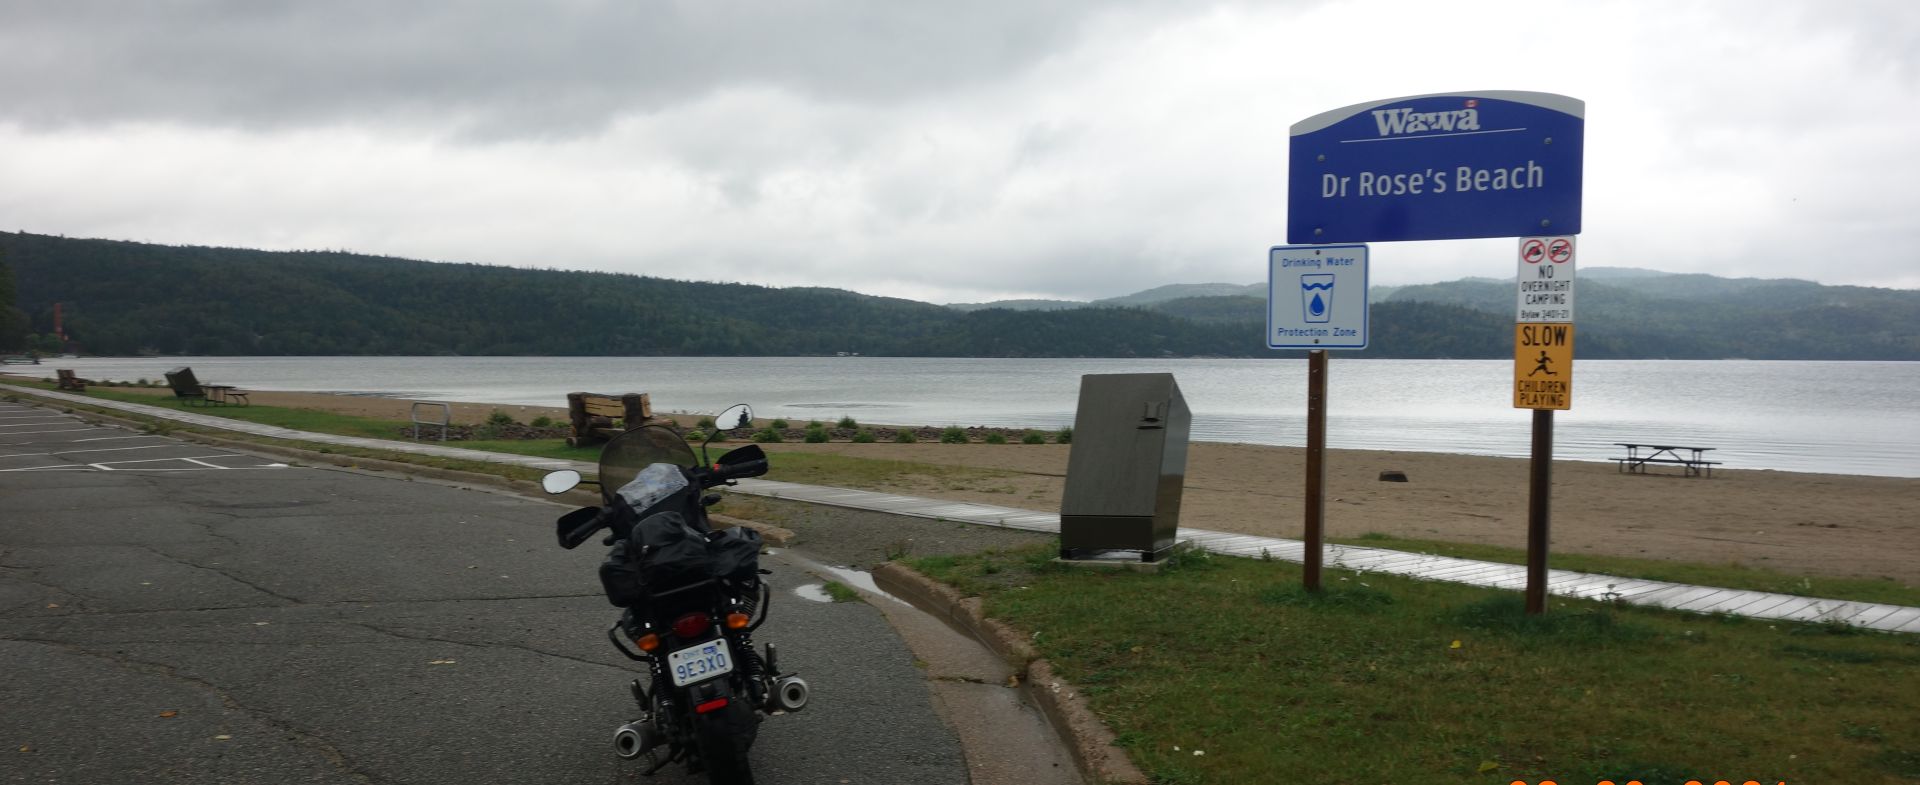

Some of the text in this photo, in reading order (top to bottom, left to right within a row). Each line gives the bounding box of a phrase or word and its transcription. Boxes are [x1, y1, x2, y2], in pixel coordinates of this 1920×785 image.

[1372, 107, 1480, 136] Wawa
[1322, 160, 1543, 198] Dr Rose's Beach
[1282, 257, 1354, 268] Drinking Water
[1538, 265, 1553, 279] NO
[1521, 280, 1570, 292] OVERNIGHT
[1525, 293, 1565, 305] CAMPING
[1278, 328, 1357, 336] Protection Zone
[1522, 326, 1567, 346] SLOW
[1518, 380, 1567, 393] CHILDREN
[1519, 393, 1564, 406] PLAYING
